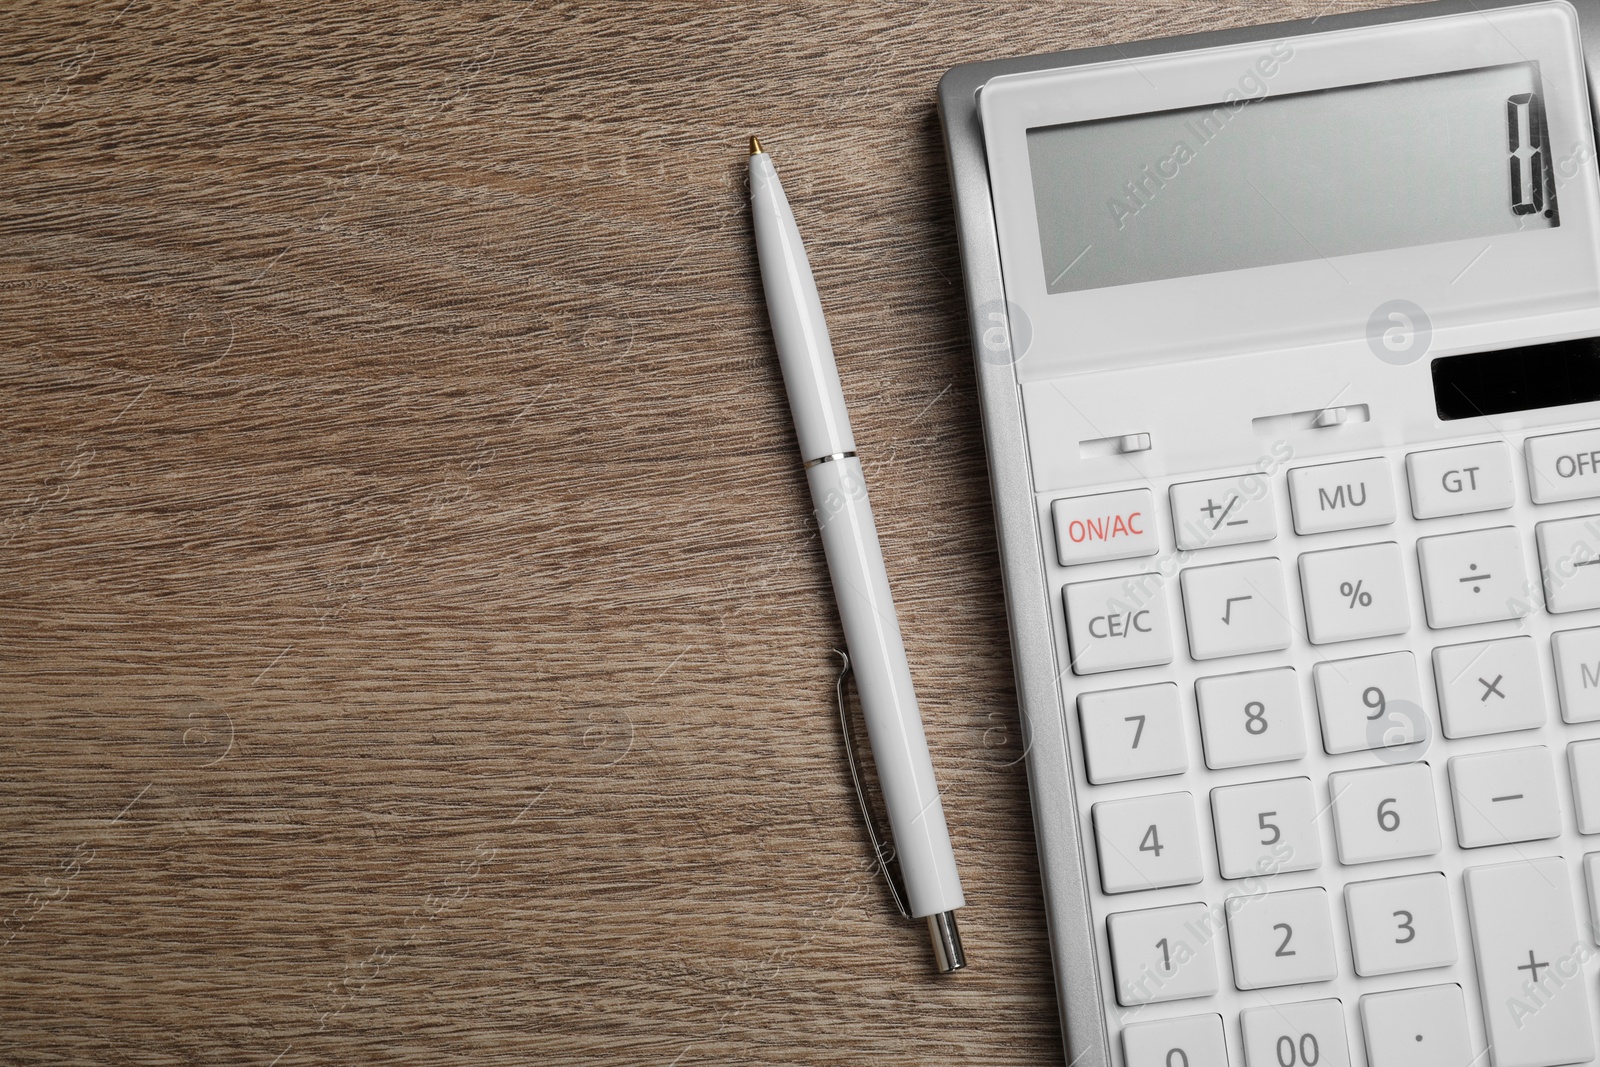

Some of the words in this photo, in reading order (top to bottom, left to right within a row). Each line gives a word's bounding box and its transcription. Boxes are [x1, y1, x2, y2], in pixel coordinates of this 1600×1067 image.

[1441, 466, 1480, 494] GT
[1556, 450, 1600, 479] OFF
[1318, 481, 1367, 511] MU
[1069, 511, 1144, 543] ON/AC
[1339, 579, 1373, 610] %
[1088, 609, 1153, 639] CE/C
[1244, 701, 1269, 736] 8
[1362, 686, 1387, 721] 9
[1124, 714, 1147, 751] 7
[1258, 811, 1281, 846] 5
[1376, 797, 1401, 833] 6
[1138, 824, 1164, 858] 4
[1272, 922, 1297, 958] 2
[1392, 909, 1416, 944] 3
[1155, 937, 1171, 971] 1
[1276, 1032, 1320, 1067] 00
